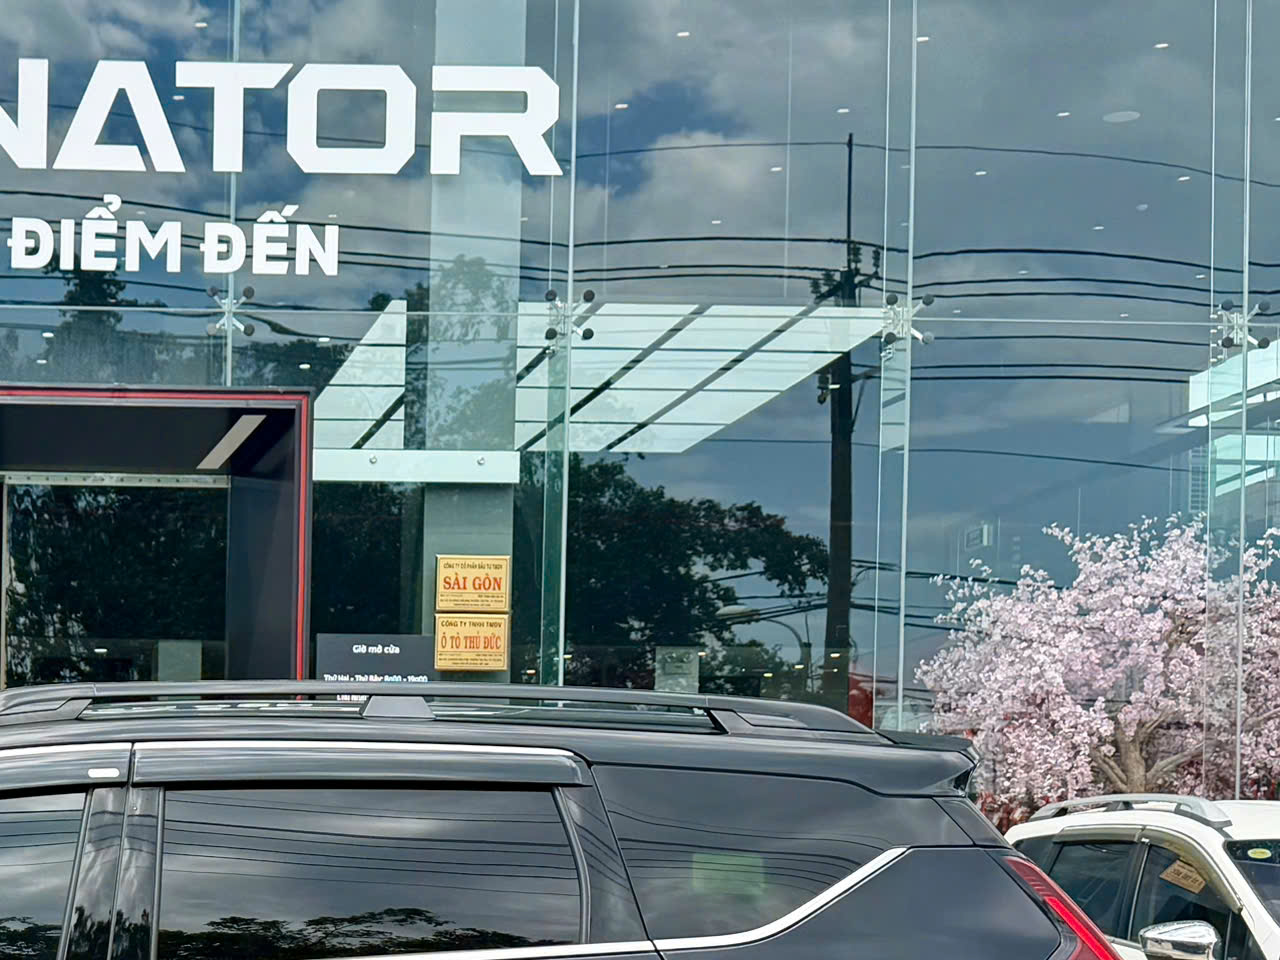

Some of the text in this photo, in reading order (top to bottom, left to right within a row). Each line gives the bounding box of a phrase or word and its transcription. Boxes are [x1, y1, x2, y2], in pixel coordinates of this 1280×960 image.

[6, 193, 183, 274] ĐIỂM
[199, 203, 340, 277] ĐẾN
[443, 572, 503, 591] SÀI GÒN
[483, 631, 502, 650] ĐỨC
